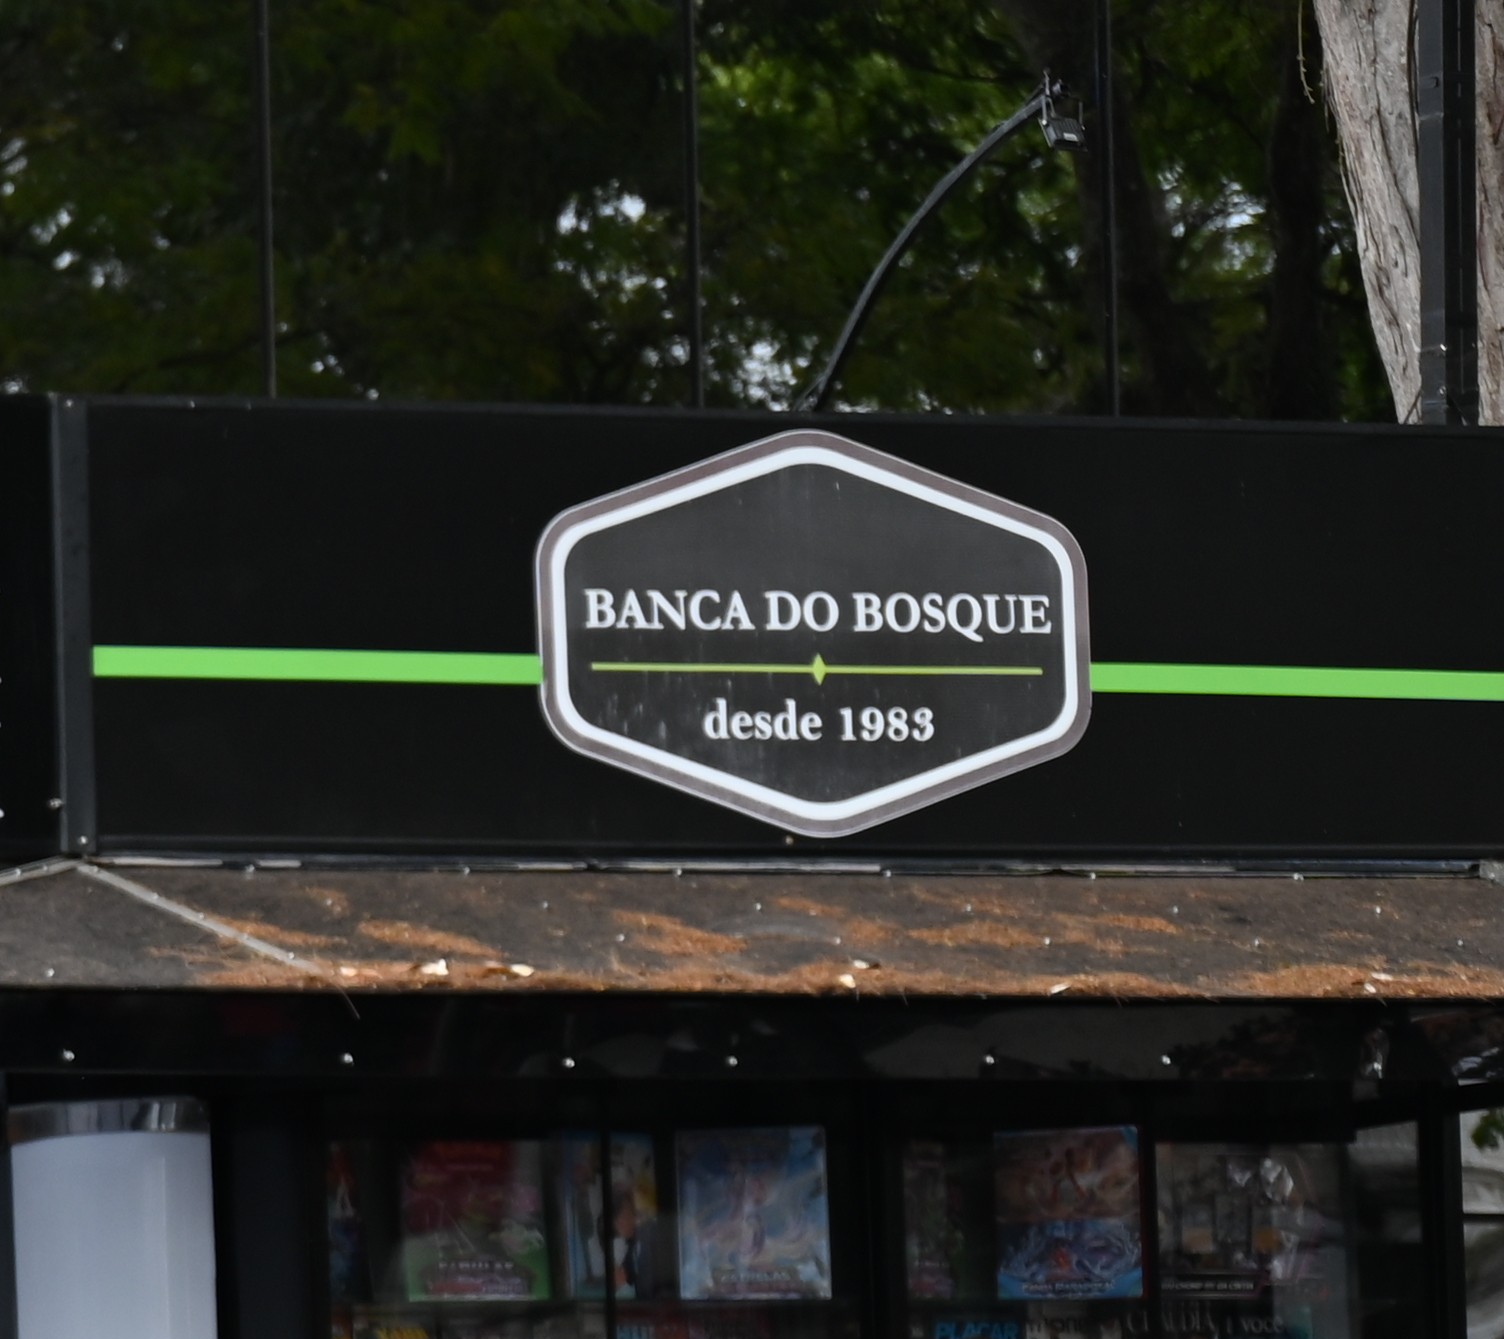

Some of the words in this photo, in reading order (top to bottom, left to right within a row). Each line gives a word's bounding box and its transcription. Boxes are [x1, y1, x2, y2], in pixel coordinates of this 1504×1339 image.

[584, 588, 756, 631] BANCA
[764, 589, 839, 632] DO
[851, 591, 1053, 643] BOSQUE
[702, 698, 824, 741] desde
